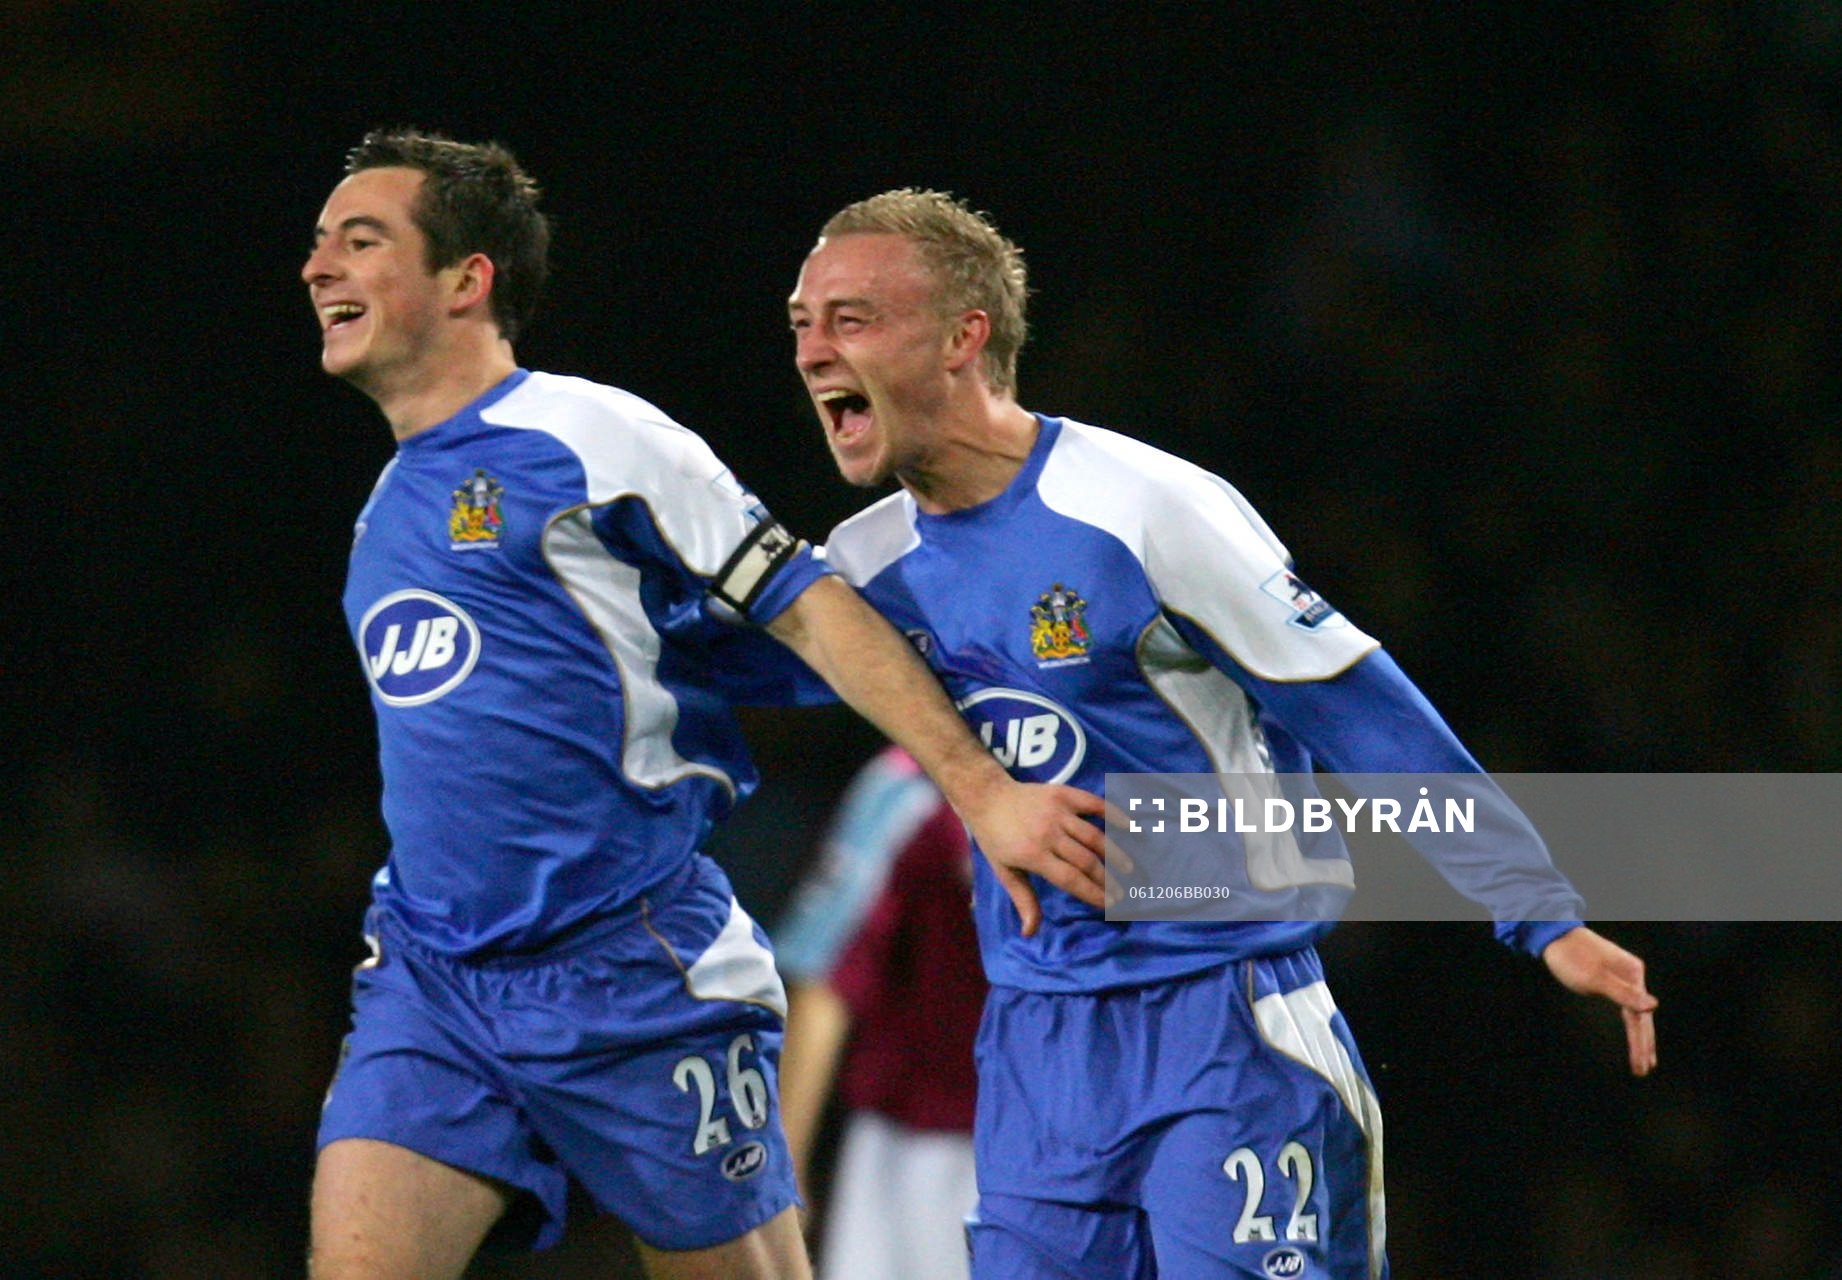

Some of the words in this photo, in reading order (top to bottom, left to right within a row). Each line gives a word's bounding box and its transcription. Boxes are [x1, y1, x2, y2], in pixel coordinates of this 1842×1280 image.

[370, 616, 459, 680] JJB
[672, 1033, 768, 1156] 26
[1223, 1141, 1318, 1244] 22
